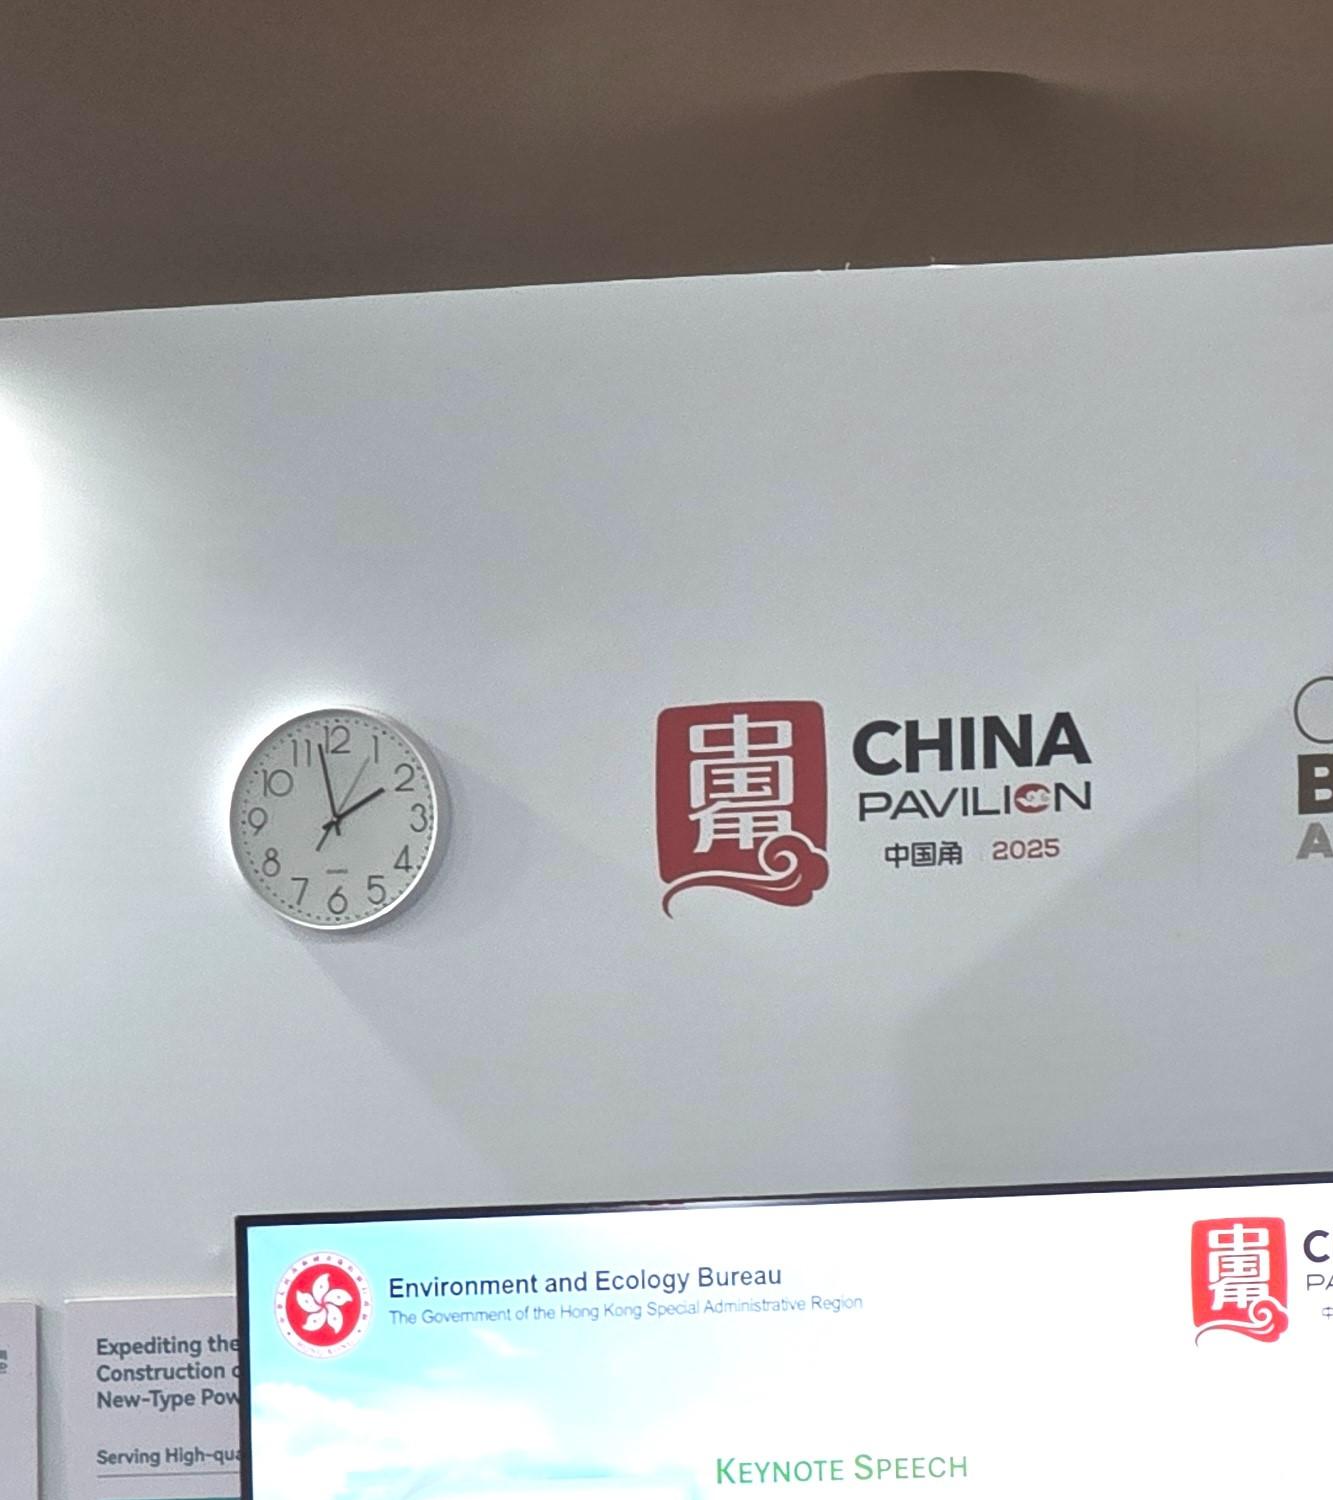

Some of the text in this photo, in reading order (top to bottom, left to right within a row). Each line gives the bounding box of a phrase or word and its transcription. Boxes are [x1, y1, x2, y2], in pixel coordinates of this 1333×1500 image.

[292, 739, 311, 767] 11
[324, 725, 350, 754] 12
[853, 711, 1092, 776] CHINA
[262, 769, 294, 797] 10
[394, 763, 415, 792] 2
[858, 781, 1092, 822] PAVILION
[248, 807, 268, 836] 9
[410, 803, 428, 832] 3
[262, 847, 281, 877] 8
[393, 844, 413, 873] 4
[884, 838, 1060, 868] 中国角 2025
[291, 877, 309, 905] 7
[327, 885, 348, 914] 6
[367, 875, 387, 905] 5
[389, 1266, 782, 1298] Environment and Ecology Bureau
[389, 1294, 863, 1325] The Government of the Hong Kong Special Administrative Region
[97, 1334, 240, 1360] Expediting the
[97, 1362, 225, 1382] Construction
[97, 1389, 196, 1412] New-Type
[97, 1448, 160, 1467] Serving
